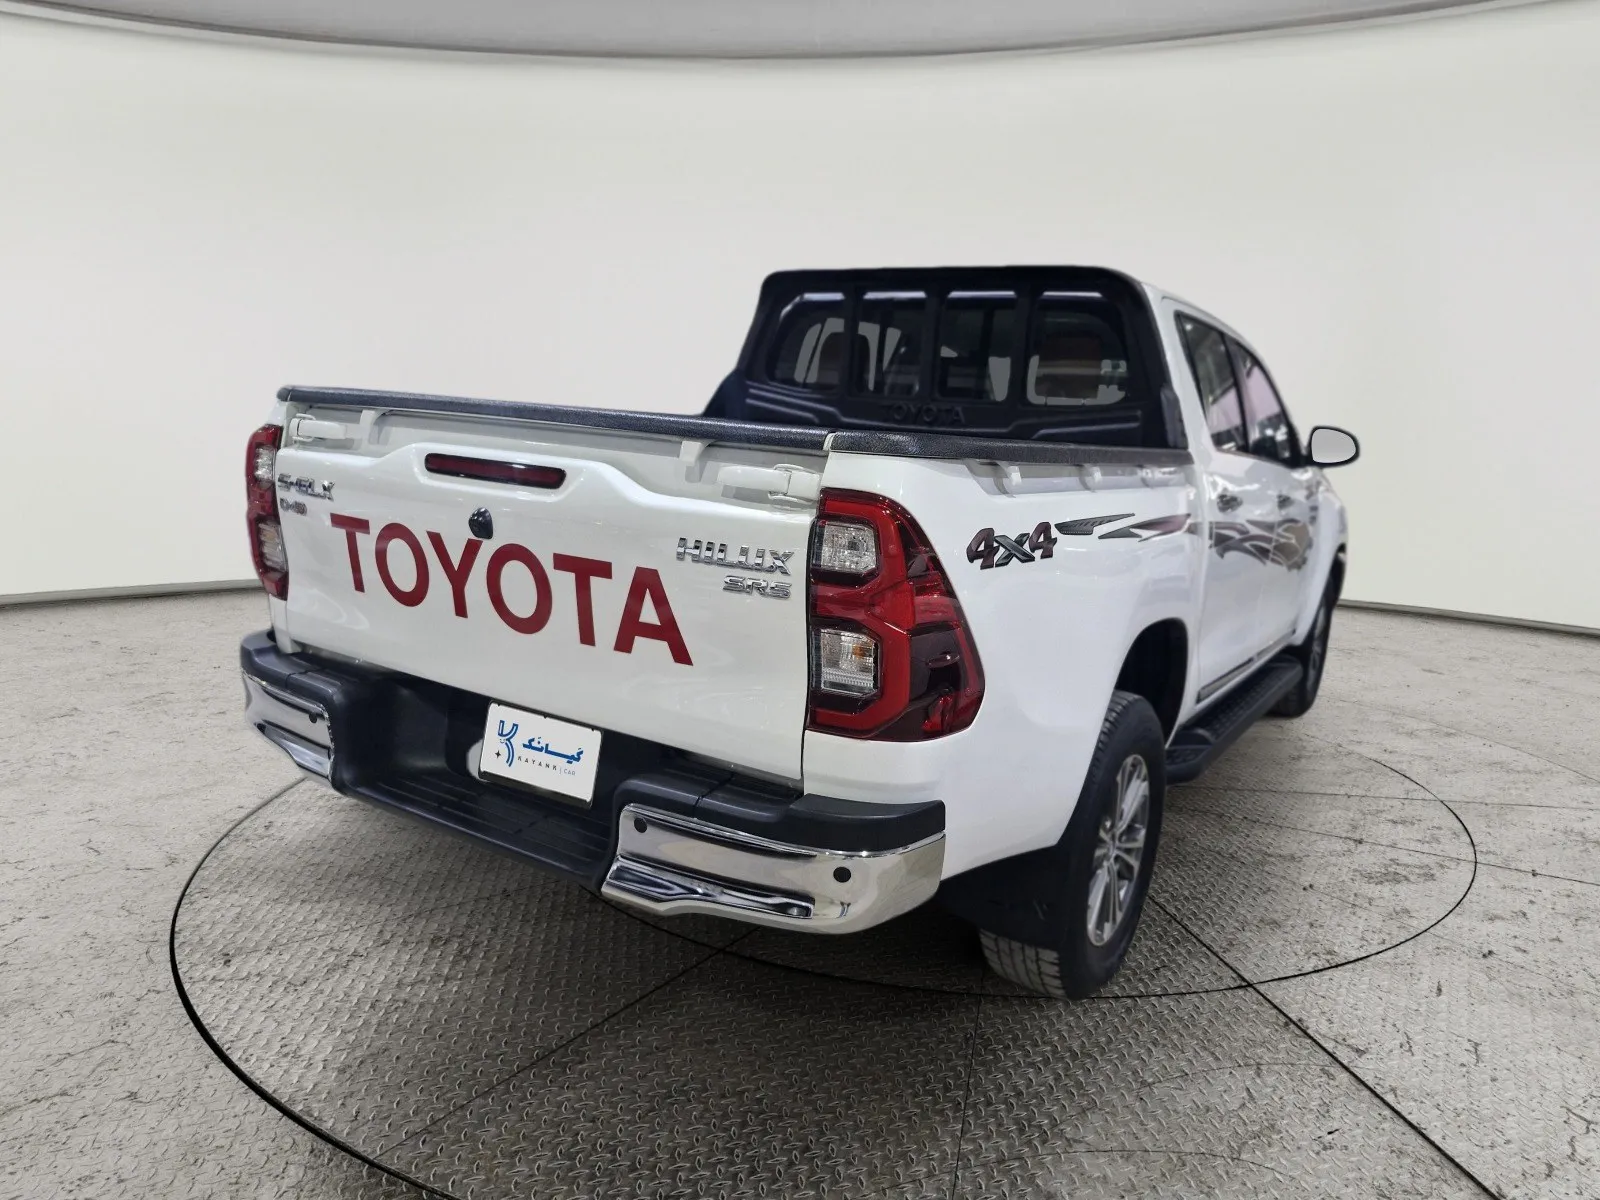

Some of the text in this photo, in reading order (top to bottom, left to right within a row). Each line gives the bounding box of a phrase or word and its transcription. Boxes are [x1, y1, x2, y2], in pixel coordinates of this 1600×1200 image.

[880, 401, 965, 424] TOYOTA
[676, 537, 794, 575] HILUX
[330, 512, 693, 666] TOYOTA
[517, 755, 558, 771] KAYANK
